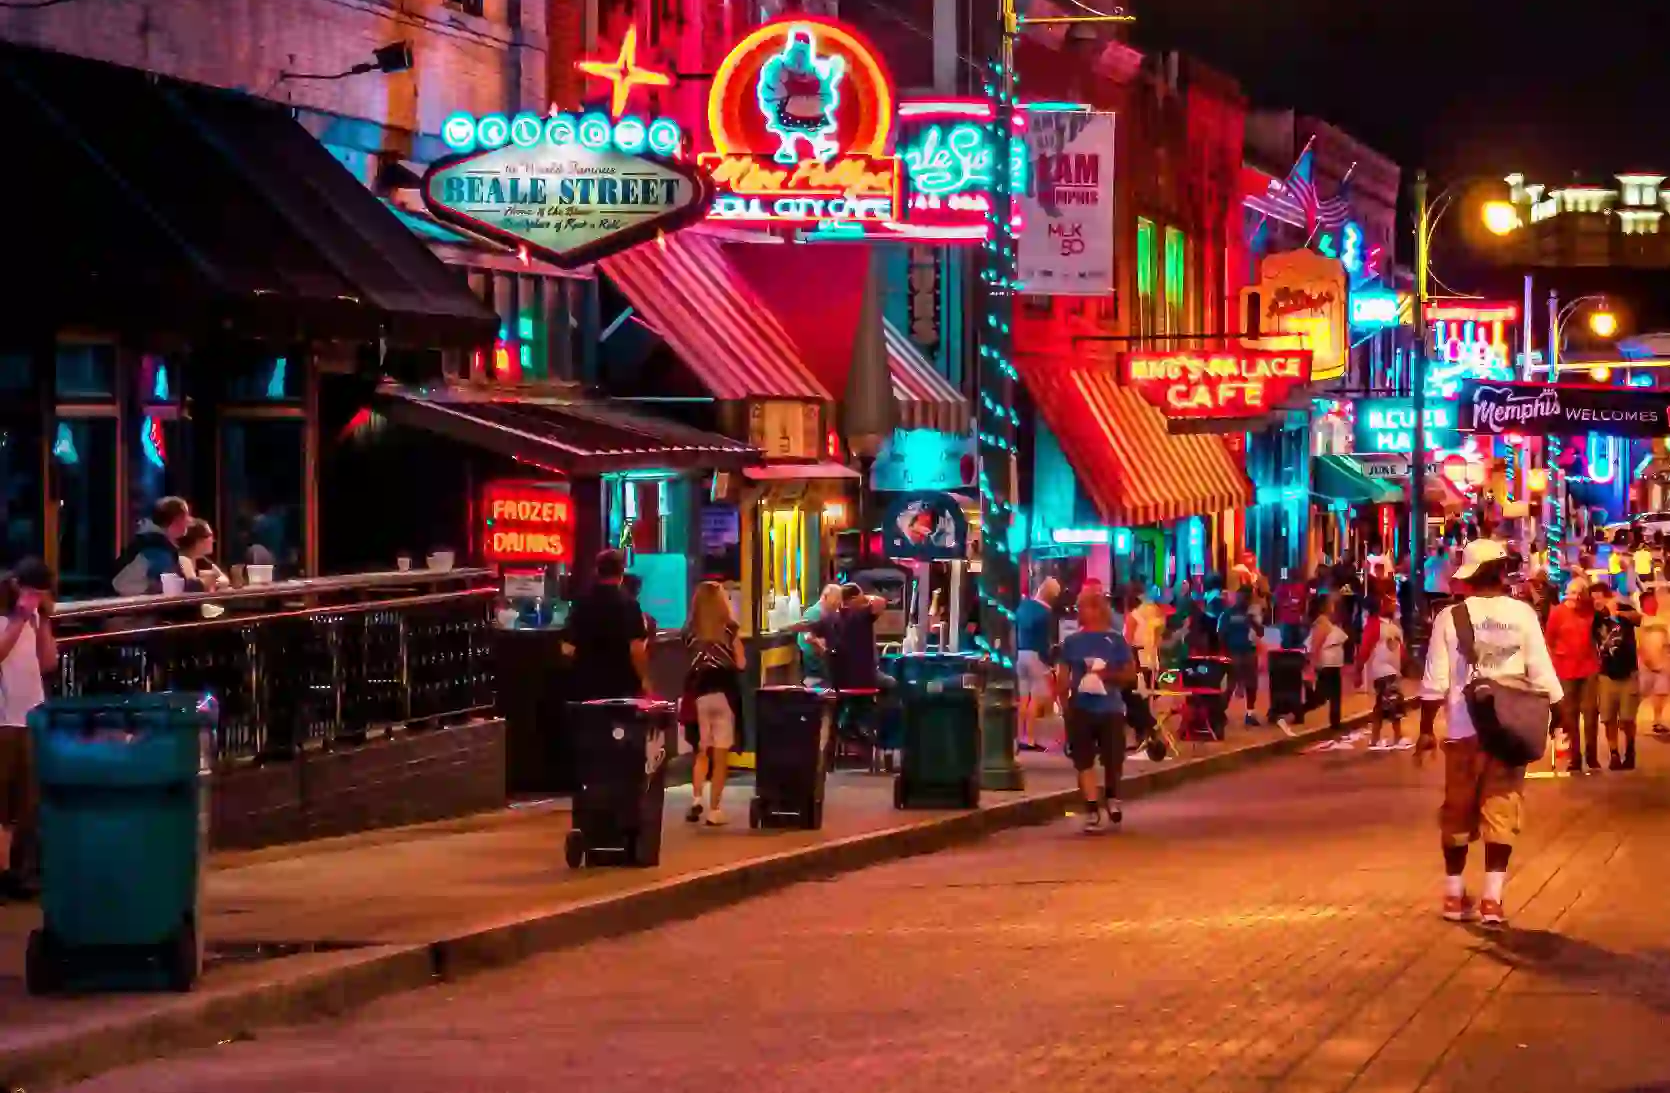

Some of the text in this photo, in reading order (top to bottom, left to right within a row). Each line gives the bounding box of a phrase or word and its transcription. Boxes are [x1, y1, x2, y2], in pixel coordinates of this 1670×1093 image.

[443, 177, 679, 206] BEALE STREET
[1166, 382, 1264, 409] CAFE
[1473, 391, 1659, 432] Memphis WELCOMES
[493, 499, 568, 523] FROZEN
[493, 532, 564, 556] DRINKS
